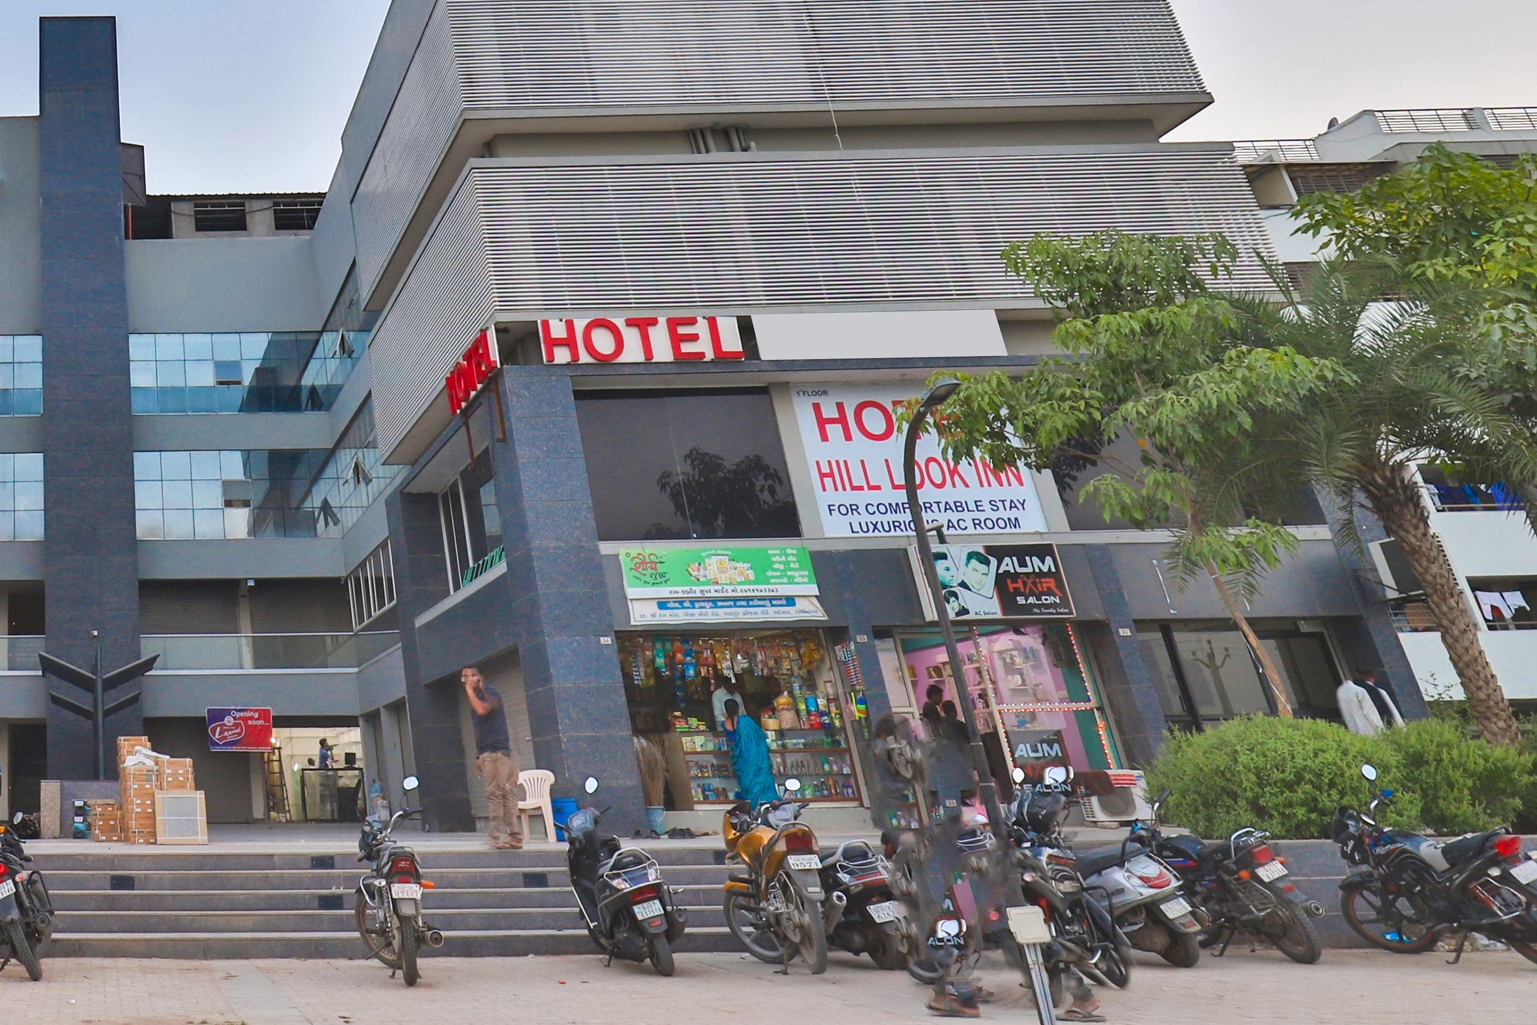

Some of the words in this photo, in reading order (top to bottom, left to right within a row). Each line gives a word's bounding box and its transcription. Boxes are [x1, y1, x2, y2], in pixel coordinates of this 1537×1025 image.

[540, 316, 745, 363] HOTEL
[815, 459, 882, 492] HILL
[827, 503, 862, 517] FOR
[864, 499, 986, 517] COMFRTABLE
[989, 498, 1027, 513] STAY
[946, 518, 967, 532] AC
[971, 516, 1022, 531] ROOM
[998, 556, 1056, 573] AUM
[1016, 595, 1060, 604] SALON
[231, 710, 259, 719] Opening
[1014, 742, 1062, 757] AUM
